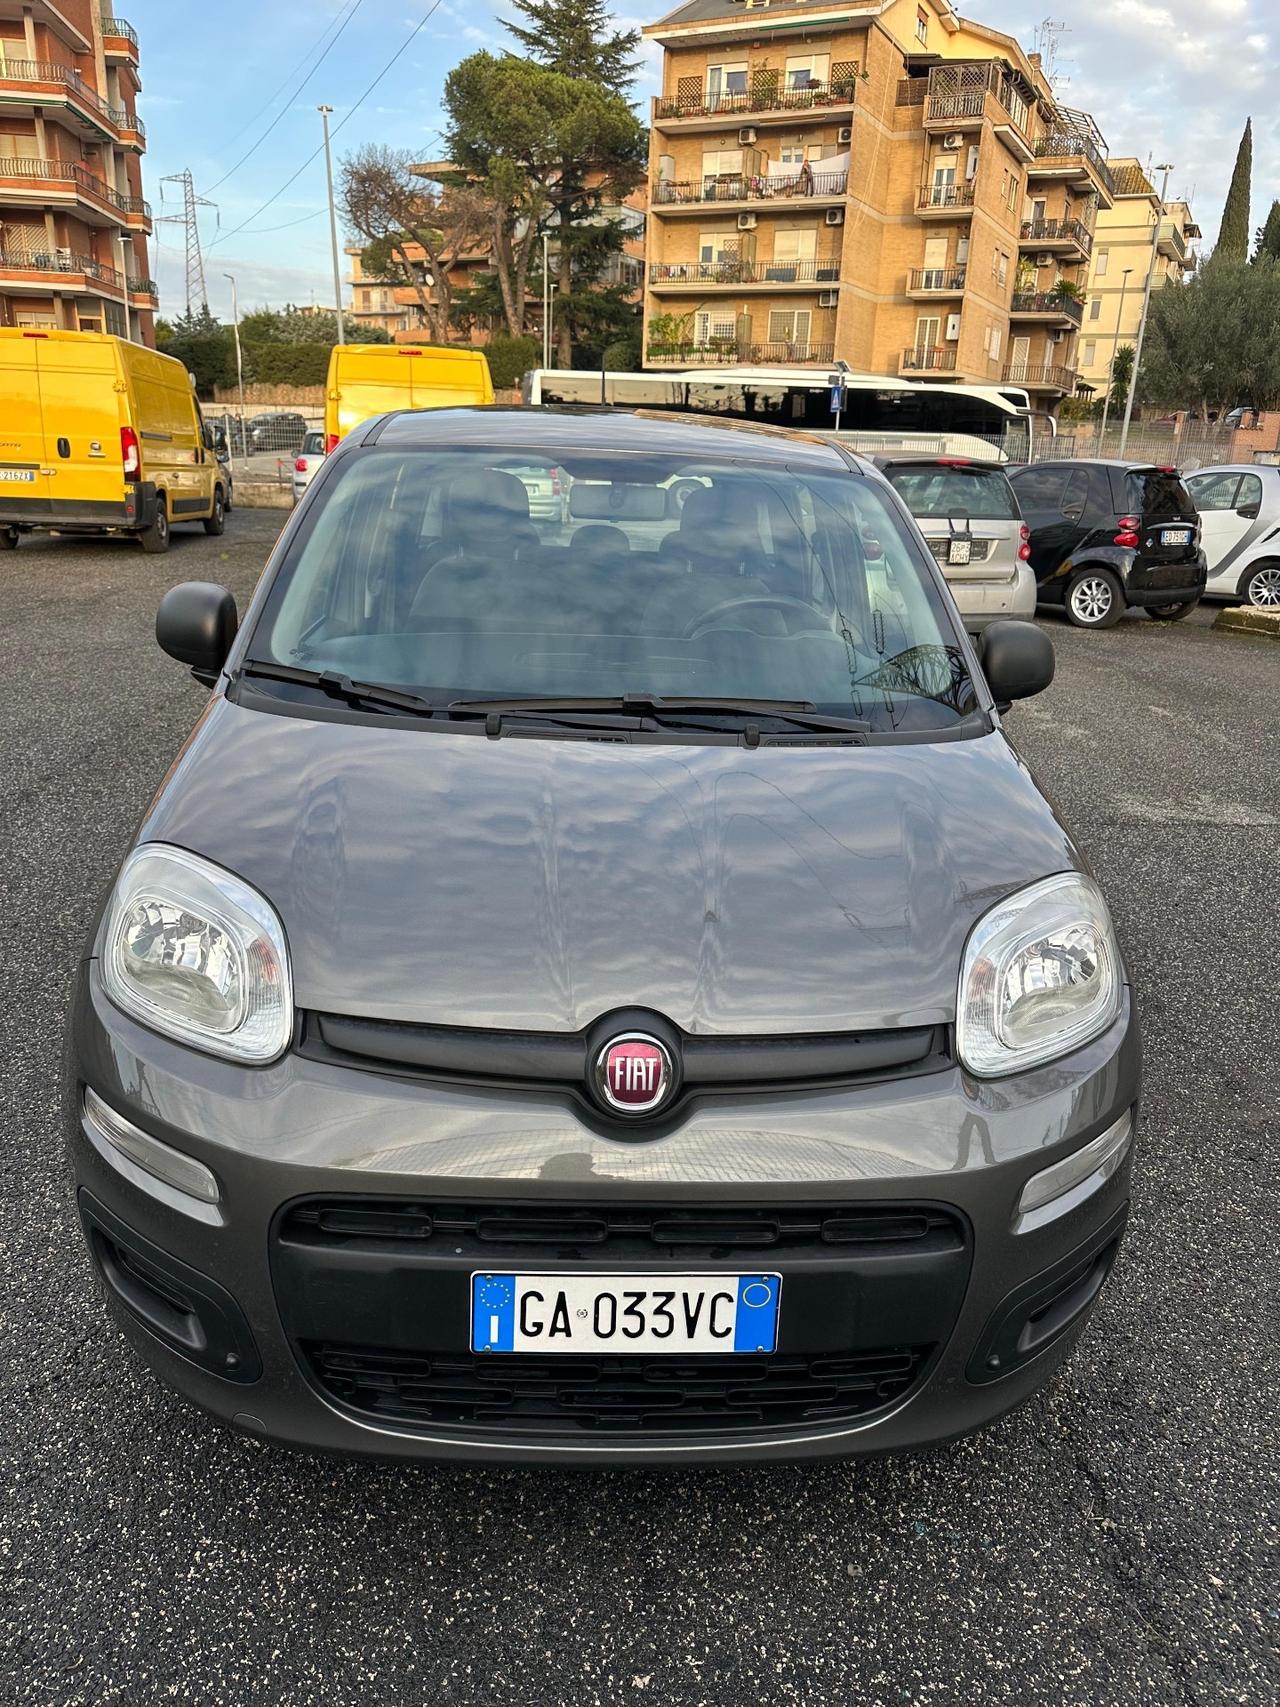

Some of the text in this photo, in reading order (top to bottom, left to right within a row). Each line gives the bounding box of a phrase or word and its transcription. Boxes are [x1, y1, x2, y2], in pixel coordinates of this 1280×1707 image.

[614, 1056, 657, 1091] FIAT
[519, 1290, 735, 1339] GA 033VC
